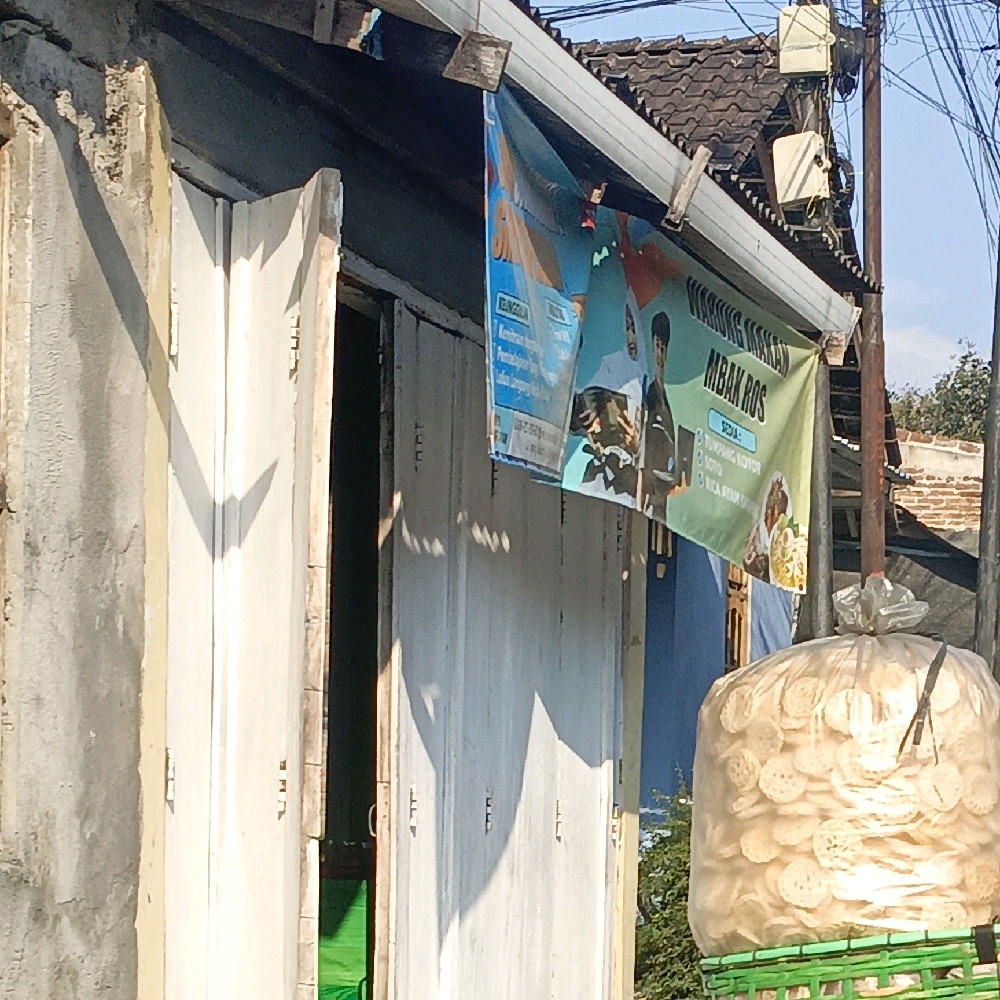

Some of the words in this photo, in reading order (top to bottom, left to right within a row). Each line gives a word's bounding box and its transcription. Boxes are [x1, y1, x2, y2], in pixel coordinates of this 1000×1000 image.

[685, 274, 745, 351] WARUNG
[743, 316, 790, 379] MAKAN
[703, 347, 745, 410] MBAK
[740, 373, 767, 424] ROS
